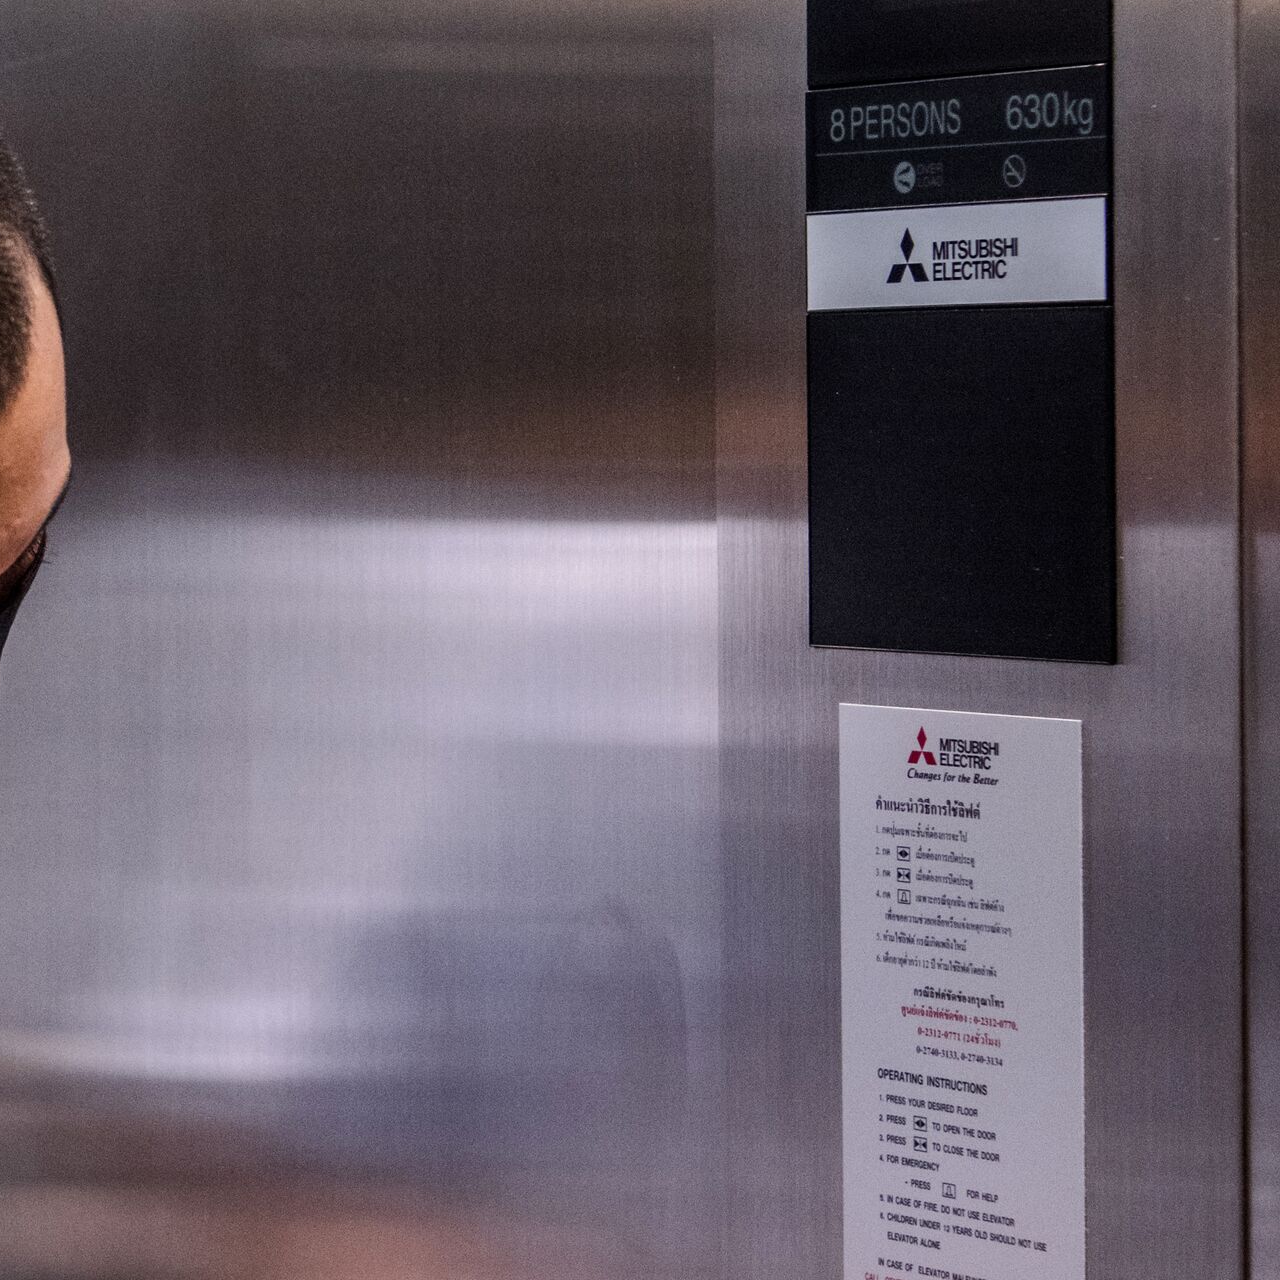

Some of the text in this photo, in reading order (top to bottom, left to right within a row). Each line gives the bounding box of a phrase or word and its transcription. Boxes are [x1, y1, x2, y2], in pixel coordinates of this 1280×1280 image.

[1006, 91, 1094, 135] 630kg
[933, 237, 1018, 260] MITSUBISHI
[933, 260, 1007, 281] ELECTRIC
[940, 738, 999, 756] MITSUBISHI
[940, 754, 991, 769] ELECTRIC
[907, 768, 999, 786] Changes for the Better
[878, 1068, 987, 1095] OPERATING INSTRUCTIONS
[886, 1095, 906, 1105] PRESS
[908, 1098, 925, 1109] YOUR
[928, 1101, 954, 1114] DESIRED
[957, 1106, 978, 1117] FLOOR
[886, 1115, 906, 1125] PRESS
[932, 1122, 941, 1131] TO
[943, 1124, 960, 1135] OPEN
[962, 1128, 975, 1138] THE
[977, 1131, 996, 1141] DOOR
[886, 1135, 906, 1145] PRESS
[932, 1143, 941, 1152] TO
[943, 1145, 964, 1157] CLOSE
[967, 1149, 978, 1158] THE
[981, 1152, 1000, 1162] DOOR
[886, 1155, 900, 1164] FOR
[902, 1158, 939, 1172] EMERGENCY
[911, 1179, 931, 1190] PRESS
[967, 1189, 998, 1203] FOR HELP
[887, 1195, 893, 1203] IN
[895, 1197, 911, 1207] CASE
[913, 1200, 921, 1209] OF
[941, 1205, 950, 1214] DO
[953, 1207, 965, 1217] NOT
[968, 1210, 980, 1219] USE
[982, 1212, 1015, 1227] ELEVATOR
[887, 1213, 917, 1226] CHILDREN
[920, 1218, 941, 1231] UNDER
[953, 1225, 972, 1238] YEARS
[975, 1230, 988, 1240] OLD
[990, 1233, 1016, 1246] SHOULD
[1018, 1238, 1031, 1248] NOT
[1034, 1241, 1047, 1252] USE
[888, 1231, 940, 1250] ELEVATOR ALONE
[878, 1258, 884, 1267] IN
[887, 1260, 903, 1270] CASE
[905, 1263, 913, 1271] OF
[918, 1266, 950, 1280] ELEVATOR
